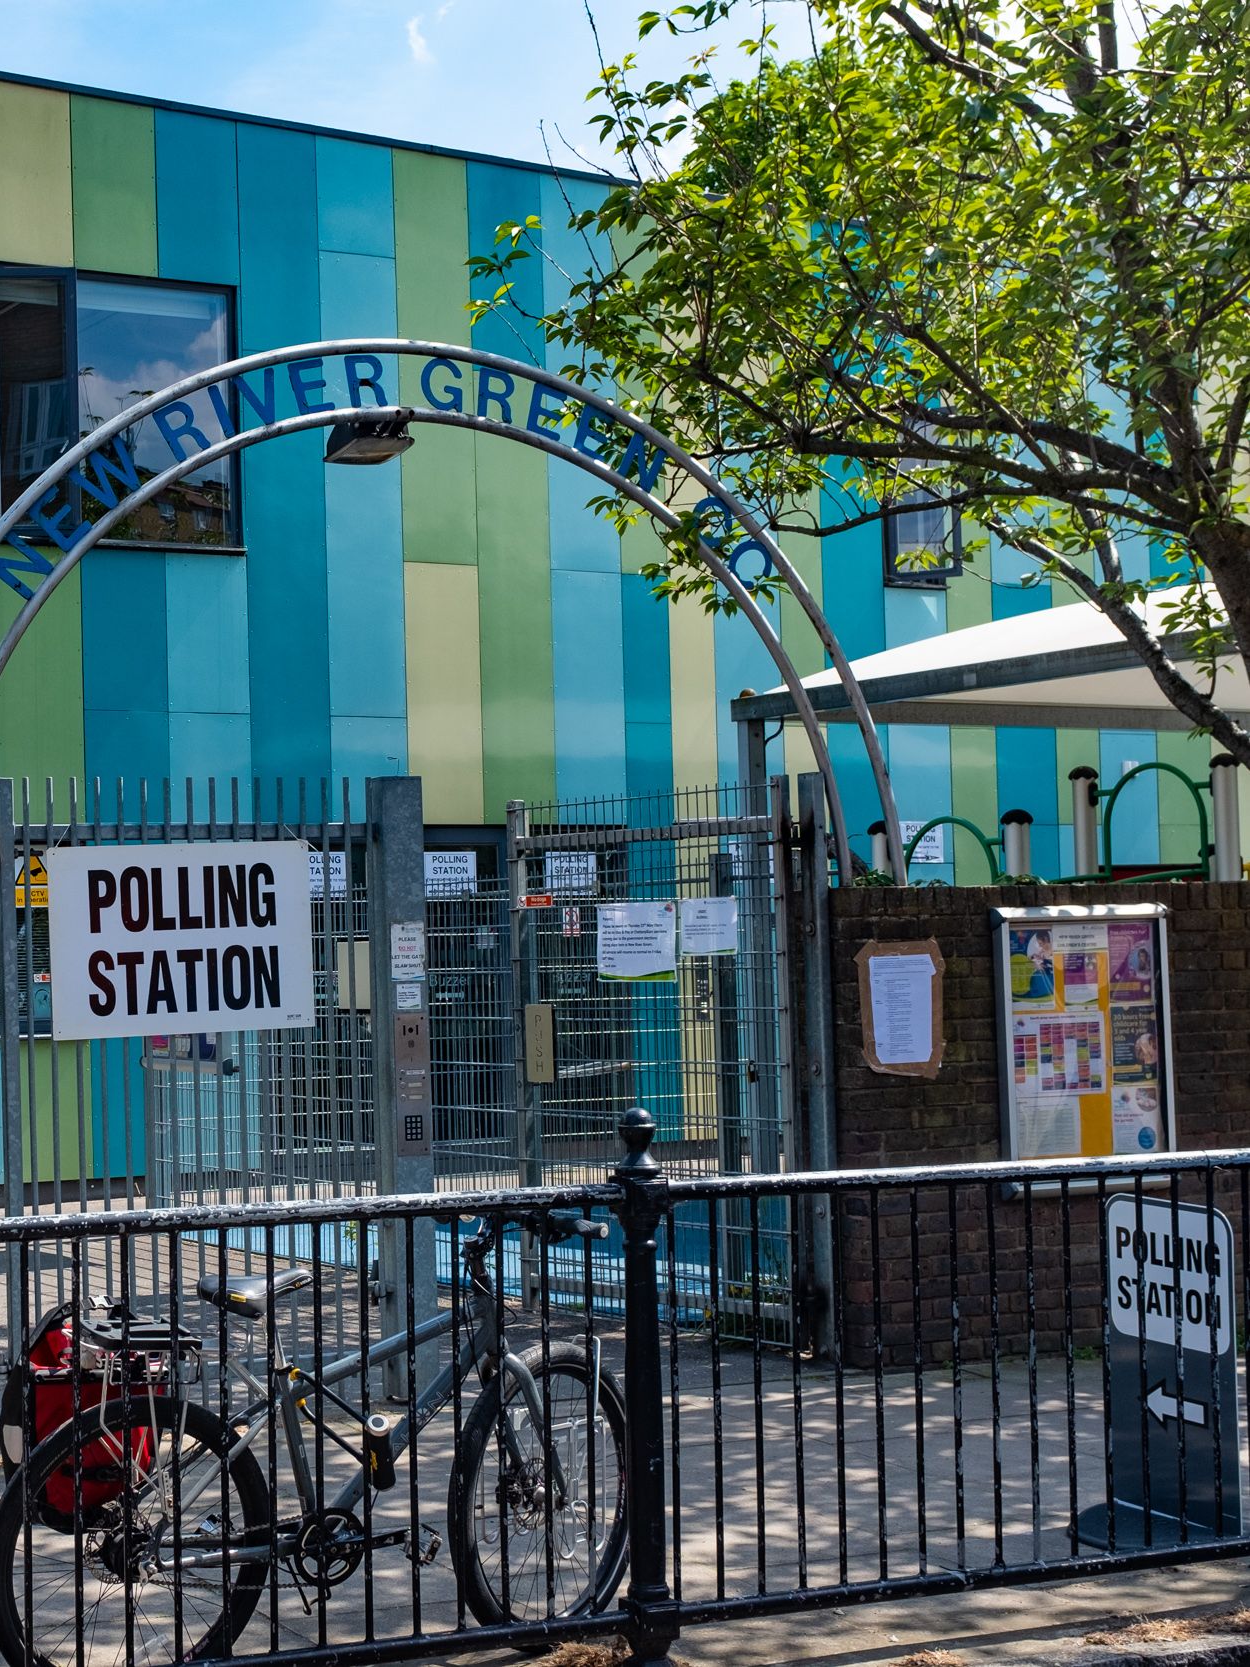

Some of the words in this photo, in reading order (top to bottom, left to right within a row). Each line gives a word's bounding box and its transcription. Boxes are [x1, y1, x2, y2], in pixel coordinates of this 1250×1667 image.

[152, 354, 389, 463] RIVER
[421, 358, 668, 493] GREEN
[432, 856, 468, 864] POLLING
[88, 862, 277, 933] POLLING
[88, 945, 281, 1016] STATION
[1116, 1226, 1221, 1278] POLLING
[1117, 1275, 1221, 1329] SATON
